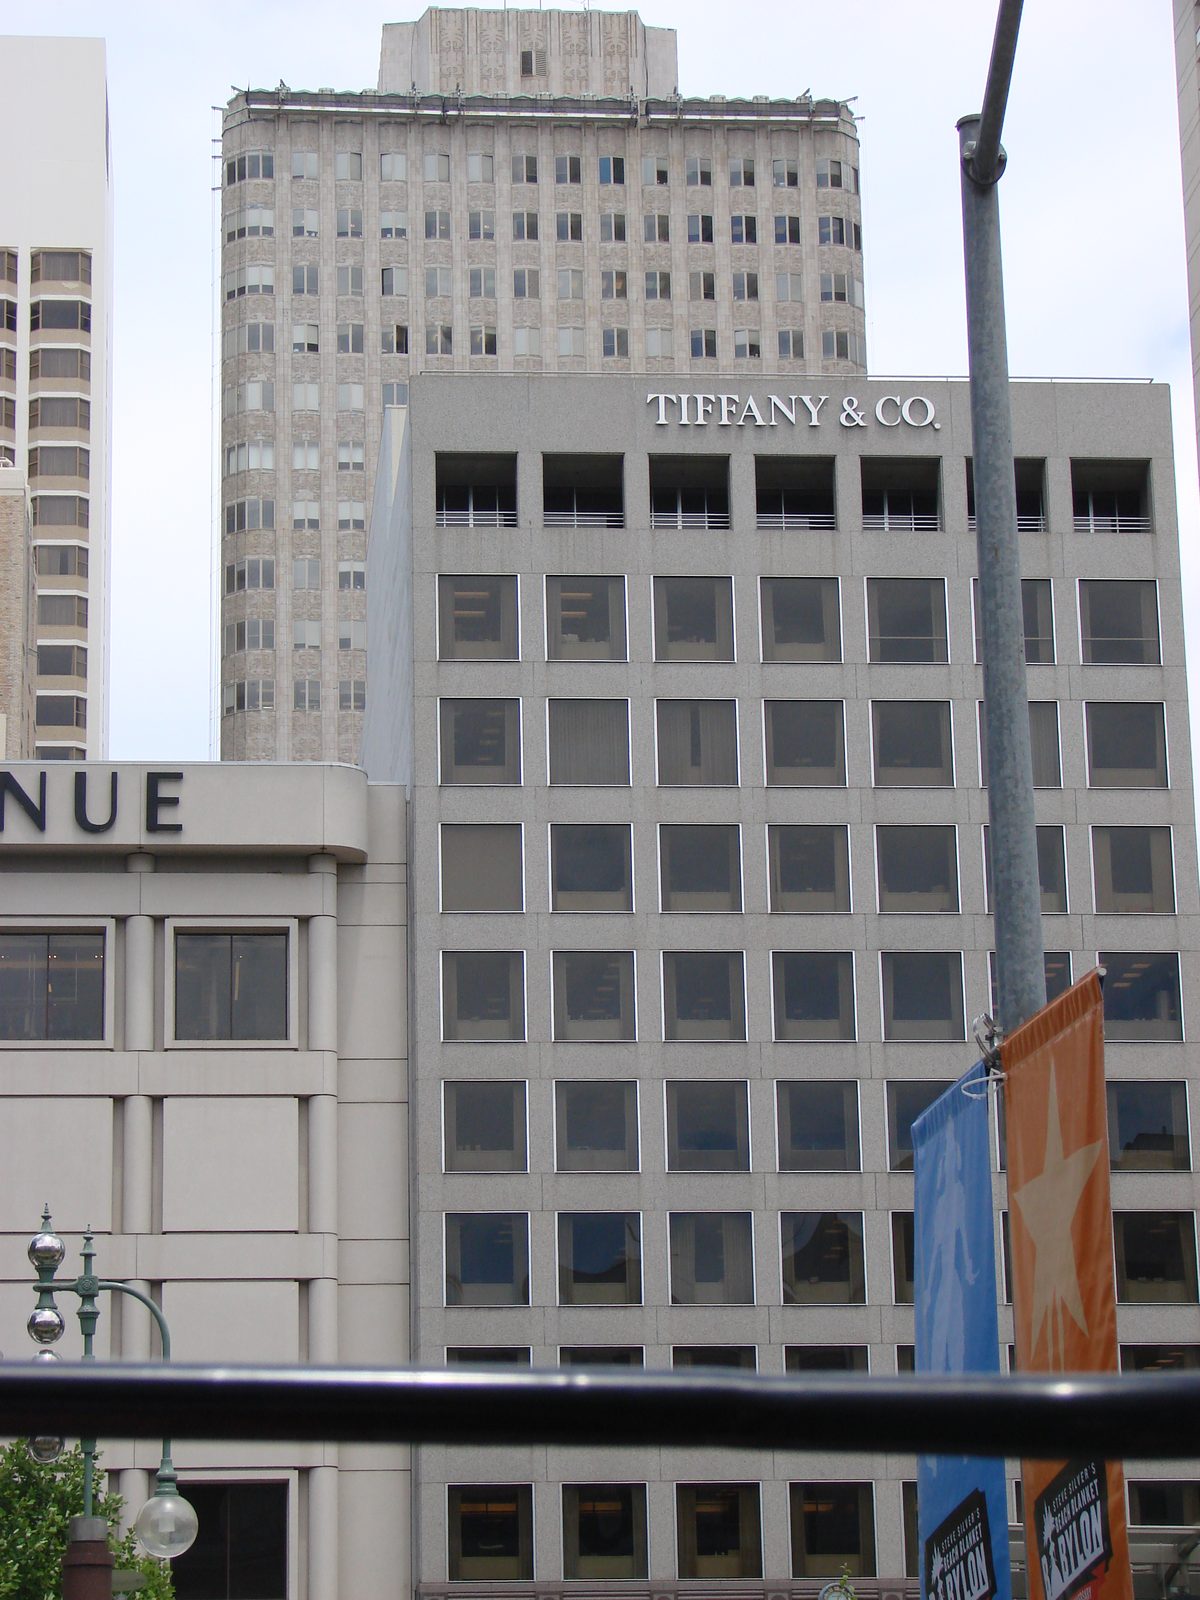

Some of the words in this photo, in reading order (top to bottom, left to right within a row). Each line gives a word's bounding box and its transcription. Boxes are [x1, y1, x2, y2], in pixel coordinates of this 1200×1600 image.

[646, 393, 829, 426] TIFFANY
[838, 396, 867, 427] &
[875, 395, 941, 429] CO.
[0, 771, 184, 834] NUE
[1053, 1487, 1068, 1512] STEVE
[1068, 1462, 1096, 1492] SILVER'S
[1054, 1501, 1072, 1533] BEACH
[1070, 1478, 1099, 1516] BLANKET
[942, 1530, 957, 1554] STEVE
[959, 1522, 982, 1556] BLANKET
